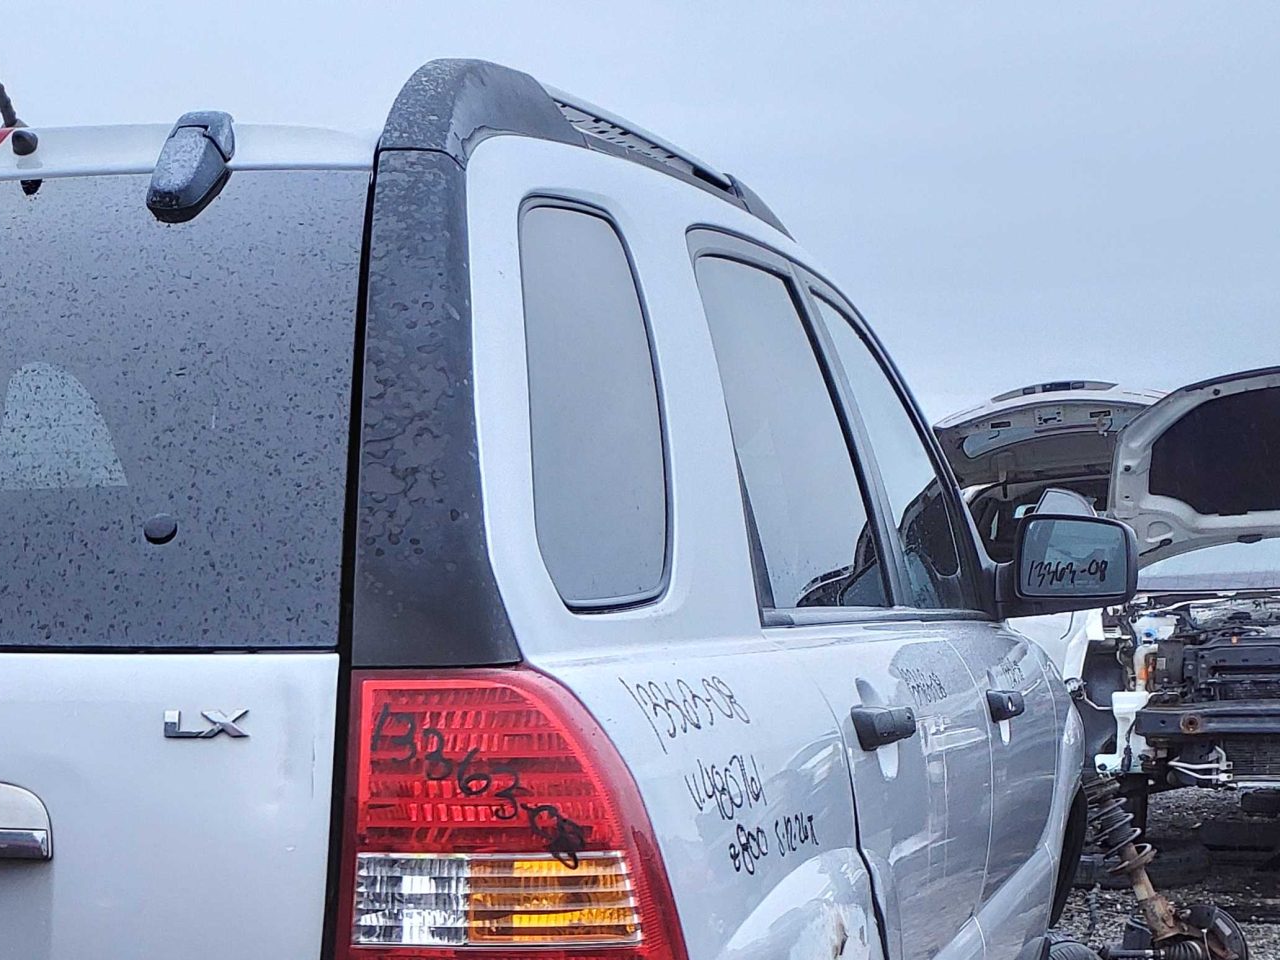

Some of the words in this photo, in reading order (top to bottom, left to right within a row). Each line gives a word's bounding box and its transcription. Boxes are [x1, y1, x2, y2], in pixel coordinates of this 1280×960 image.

[1028, 559, 1109, 588] 13363-08
[163, 709, 250, 739] LX
[618, 675, 751, 755] 13363-08
